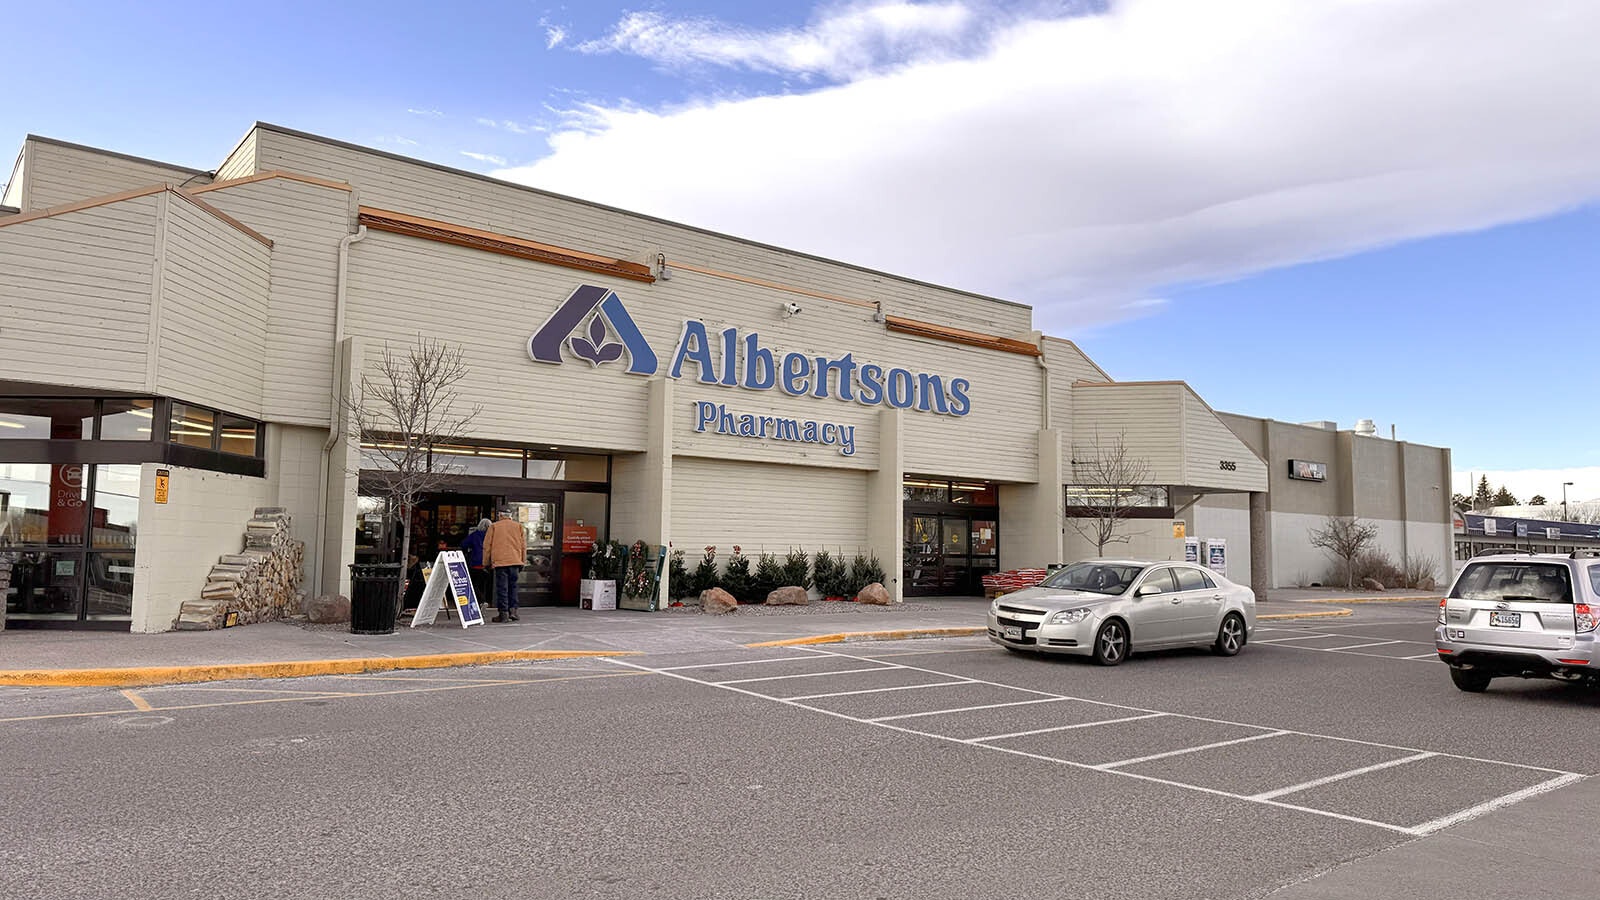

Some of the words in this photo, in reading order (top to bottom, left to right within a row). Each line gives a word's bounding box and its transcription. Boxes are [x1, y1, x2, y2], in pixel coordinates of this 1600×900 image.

[668, 319, 971, 416] Albertsons
[694, 401, 856, 456] Pharmacy
[1219, 460, 1236, 471] 3355
[57, 499, 65, 507] &
[67, 499, 83, 507] Go
